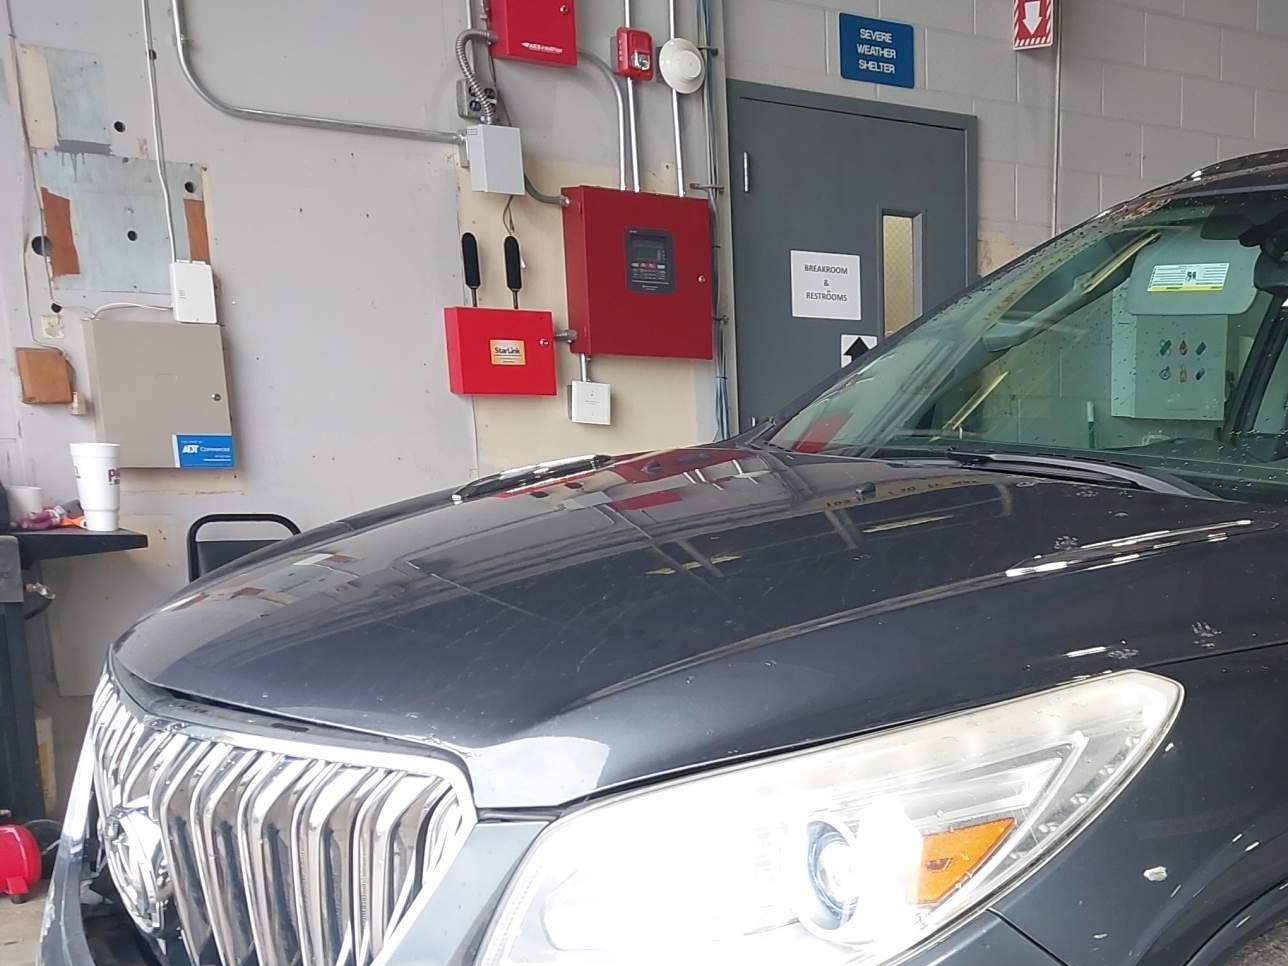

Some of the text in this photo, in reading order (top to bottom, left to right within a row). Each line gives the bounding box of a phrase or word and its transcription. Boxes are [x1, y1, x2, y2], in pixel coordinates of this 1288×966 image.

[860, 28, 893, 43] SEVERE
[856, 43, 897, 59] WEATHER
[858, 59, 896, 74] SHELTER
[804, 264, 848, 275] BREAKROOM
[823, 279, 830, 287] &
[806, 292, 848, 302] RESTROOMS
[494, 346, 520, 354] StarLink
[182, 444, 200, 454] ADT
